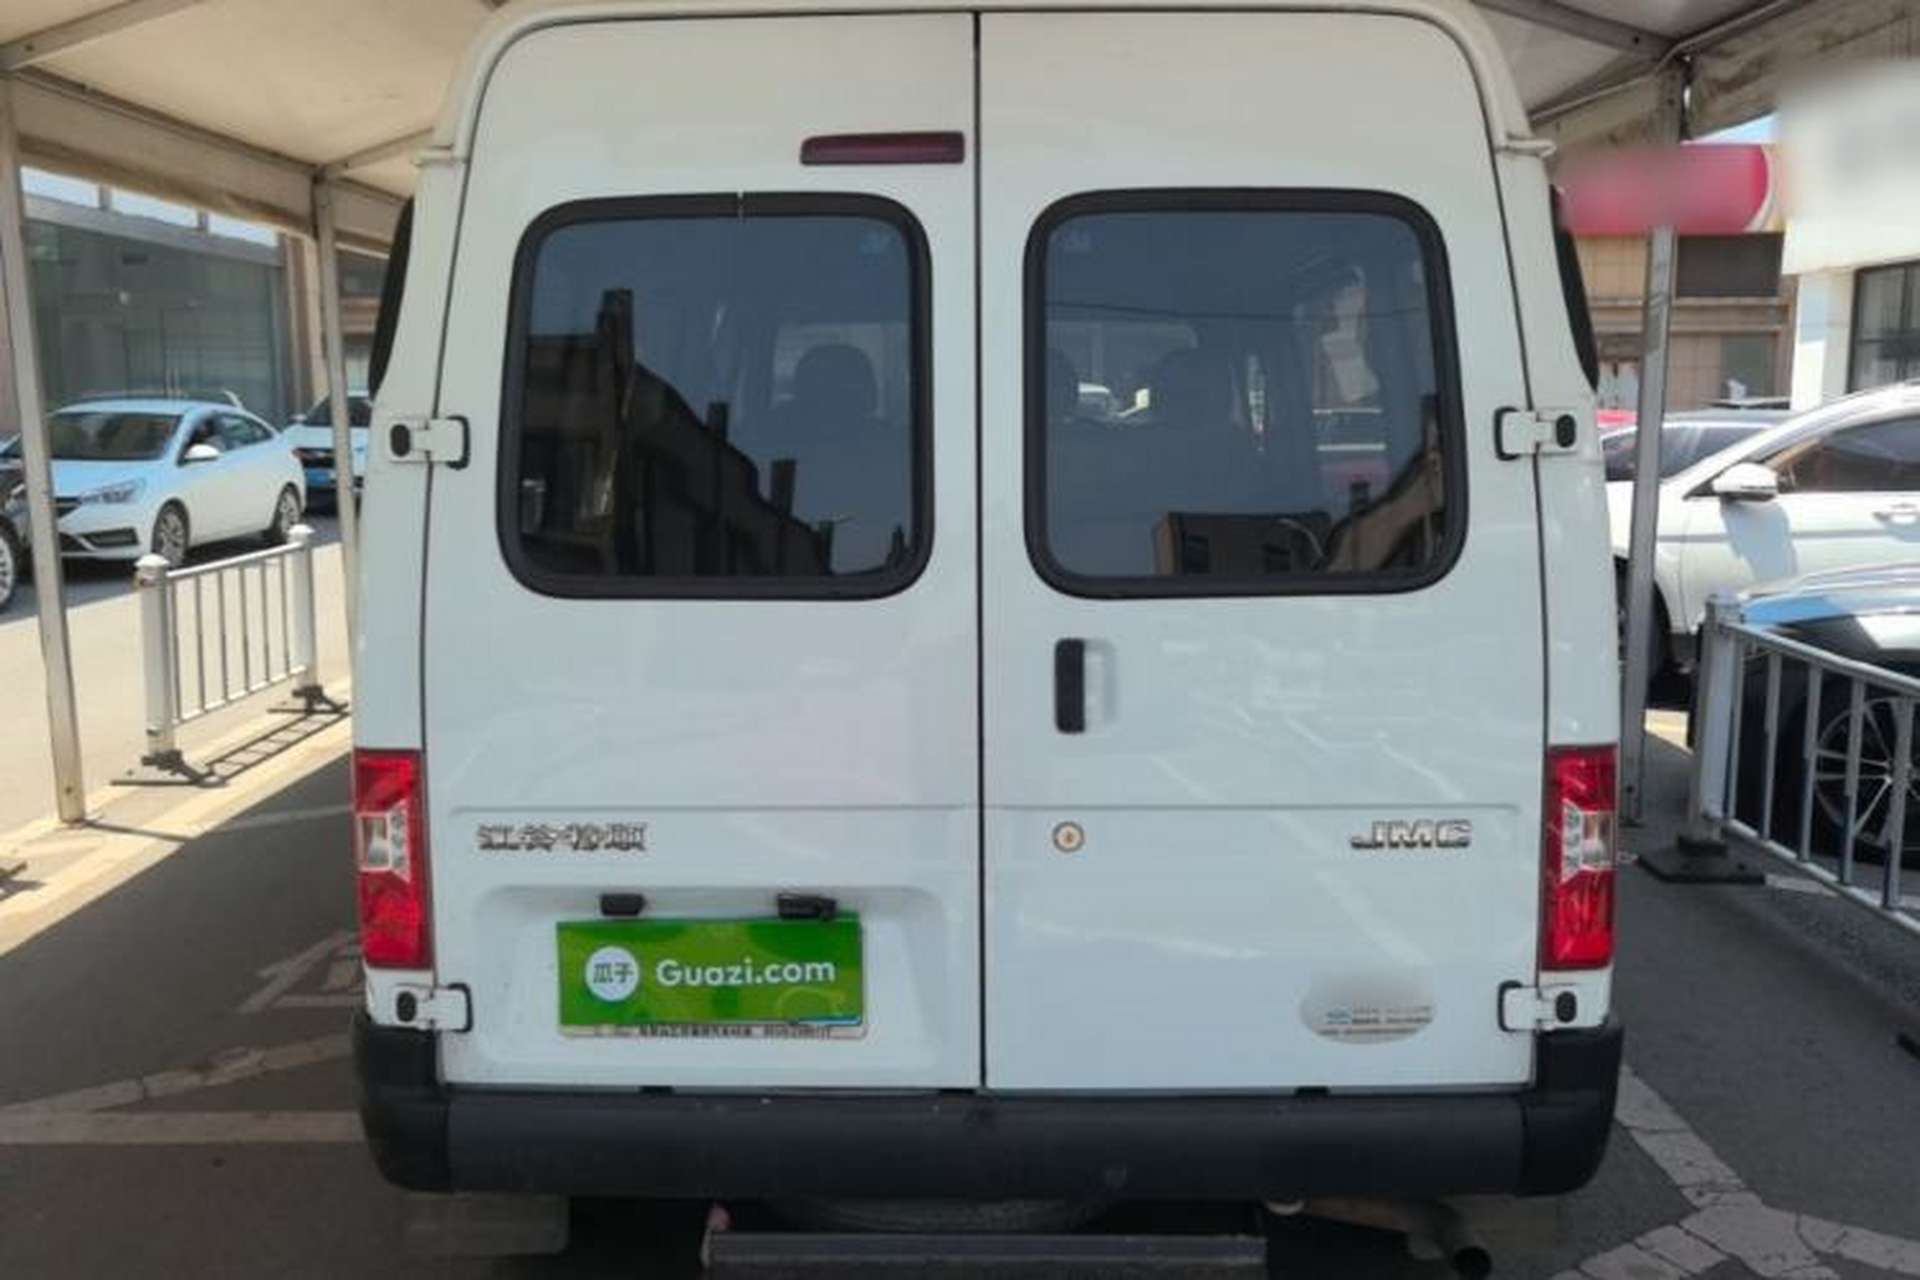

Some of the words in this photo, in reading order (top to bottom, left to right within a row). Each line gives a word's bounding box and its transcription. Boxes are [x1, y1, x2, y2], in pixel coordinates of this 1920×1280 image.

[1350, 819, 1470, 848] JMC
[593, 961, 634, 984] 瓜子
[656, 958, 835, 987] Guazi.com
